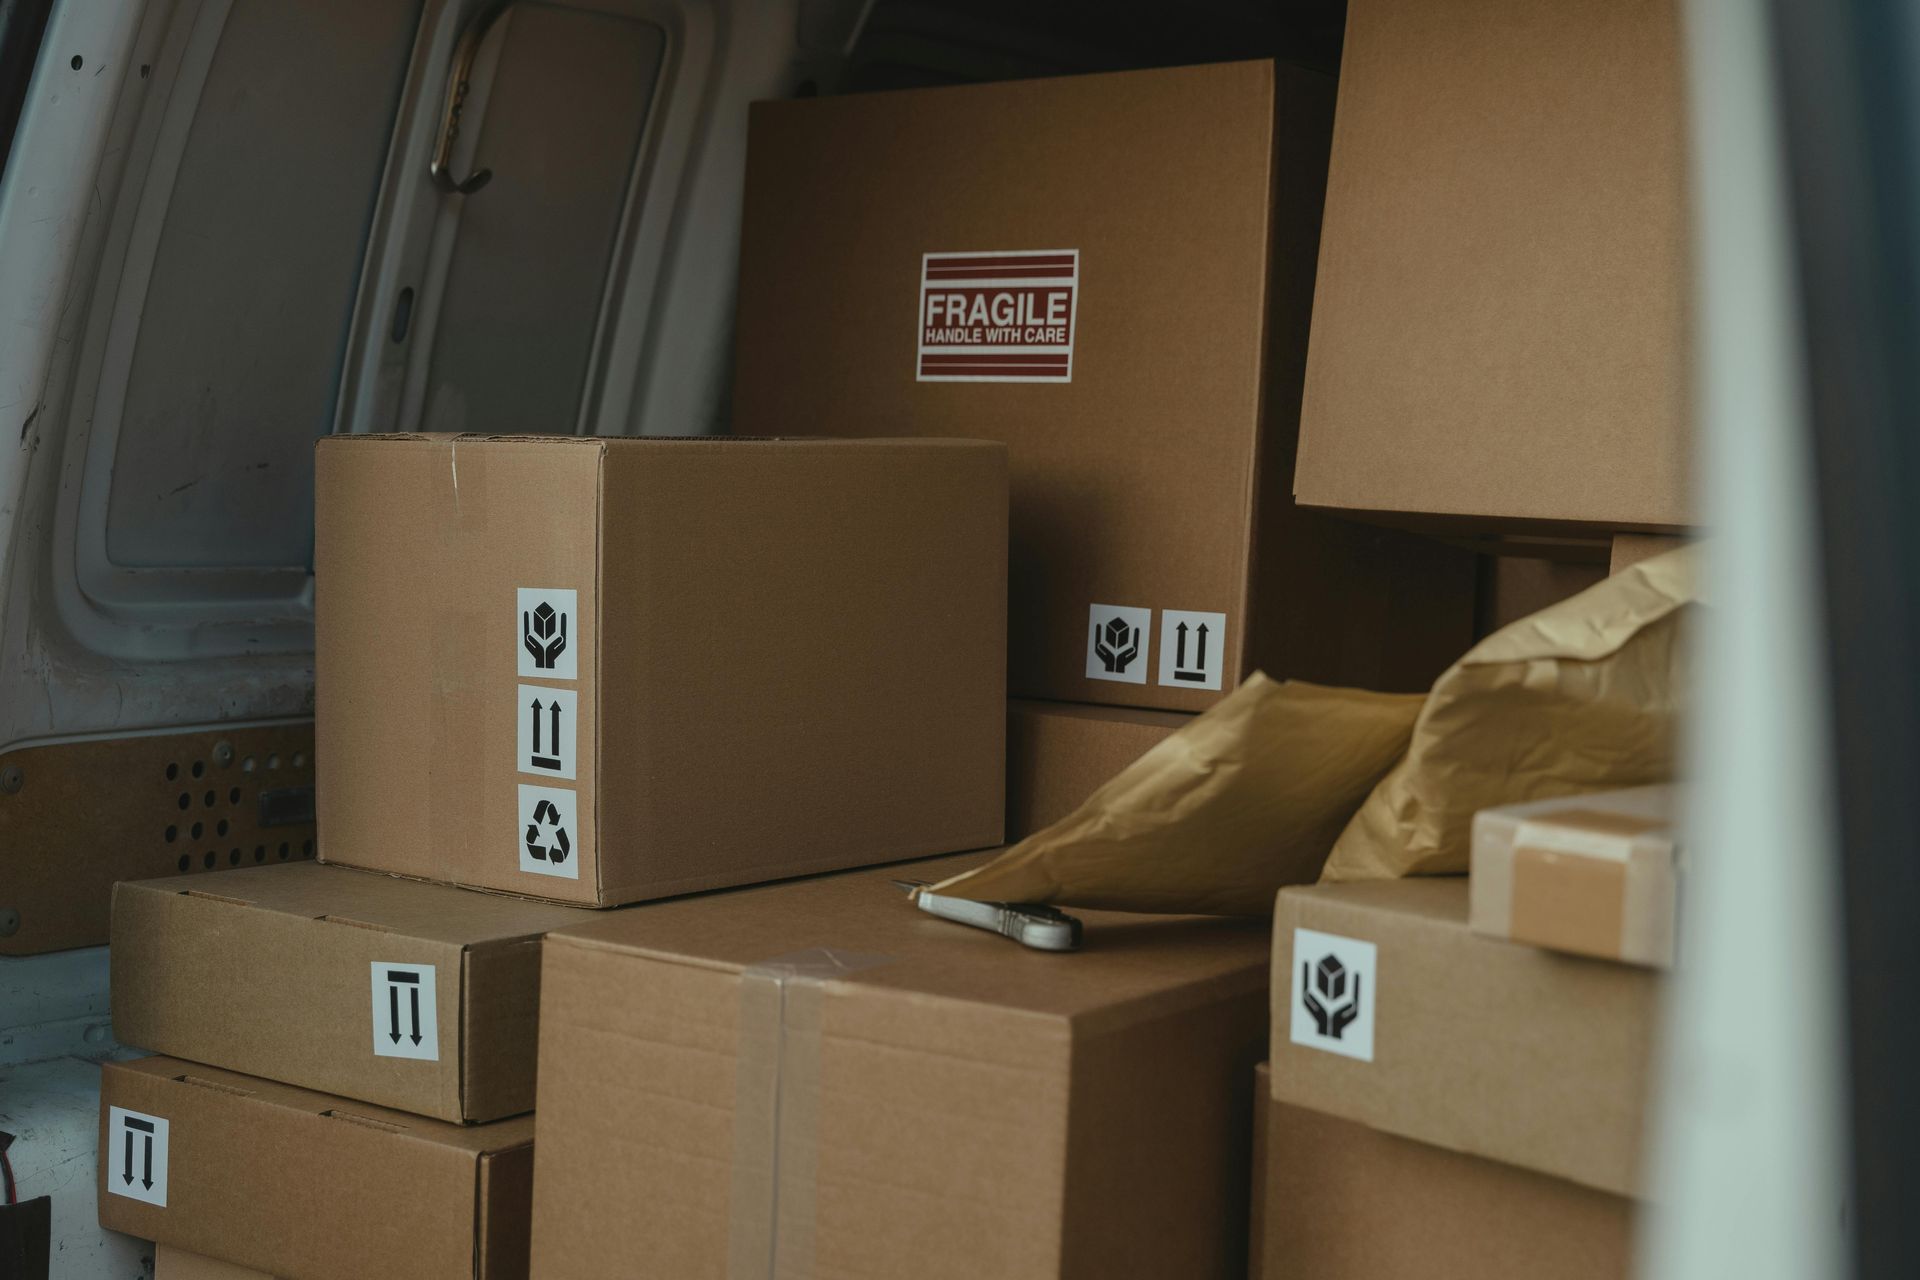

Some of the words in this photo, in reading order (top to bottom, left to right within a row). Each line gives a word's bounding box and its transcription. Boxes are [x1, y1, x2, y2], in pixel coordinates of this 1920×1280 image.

[926, 292, 1068, 326] FRAGILE
[926, 328, 982, 343] HANDLE
[986, 328, 1021, 343] WITH
[1024, 328, 1066, 343] CARE
